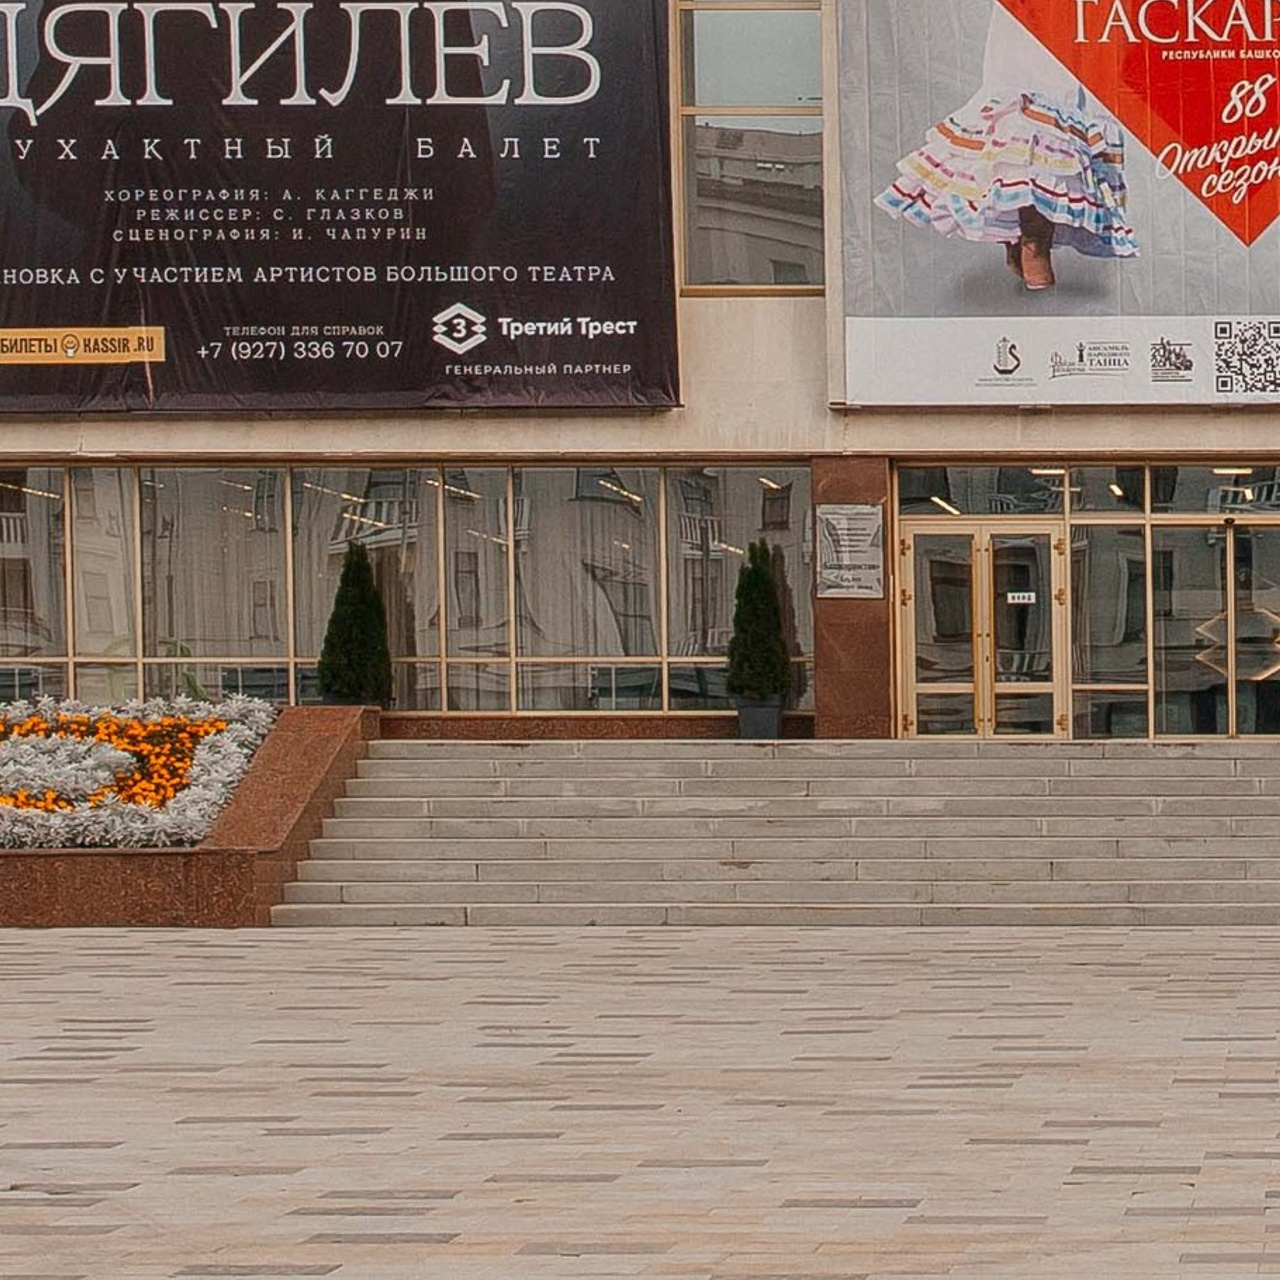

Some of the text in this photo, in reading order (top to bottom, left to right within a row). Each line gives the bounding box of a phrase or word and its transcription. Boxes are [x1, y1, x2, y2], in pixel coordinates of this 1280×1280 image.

[1161, 49, 1236, 61] РЕСПУБЛИКИ
[1221, 73, 1277, 124] 88
[416, 136, 600, 159] БАЛЕТ
[104, 188, 434, 202] ХОРЕОГРАФИЯ: А. КАГГЕДЖИ
[136, 207, 404, 221] РЕЖИССЕР: С. ГЛАЗКОВ
[113, 227, 427, 242] СЦЕНОГРАФИЯ: И. ЧАПУРИН
[90, 268, 104, 284] С
[115, 267, 243, 284] УЧАСТИЕМ
[253, 266, 377, 283] АРТИСТОВ
[386, 266, 518, 282] БОЛЬШОГО
[528, 265, 616, 282] ТЕАТРА
[224, 325, 384, 338] ТЕЛЕФОН ДЛЯ СПРАВОК
[498, 317, 638, 339] Третий Трест
[0, 338, 58, 354] БИЛЕТЫ
[197, 341, 403, 360] +7 (927) 336 70 07
[445, 362, 632, 375] ГЕНЕРАЛЬНЫЙ ПАРТНЕР
